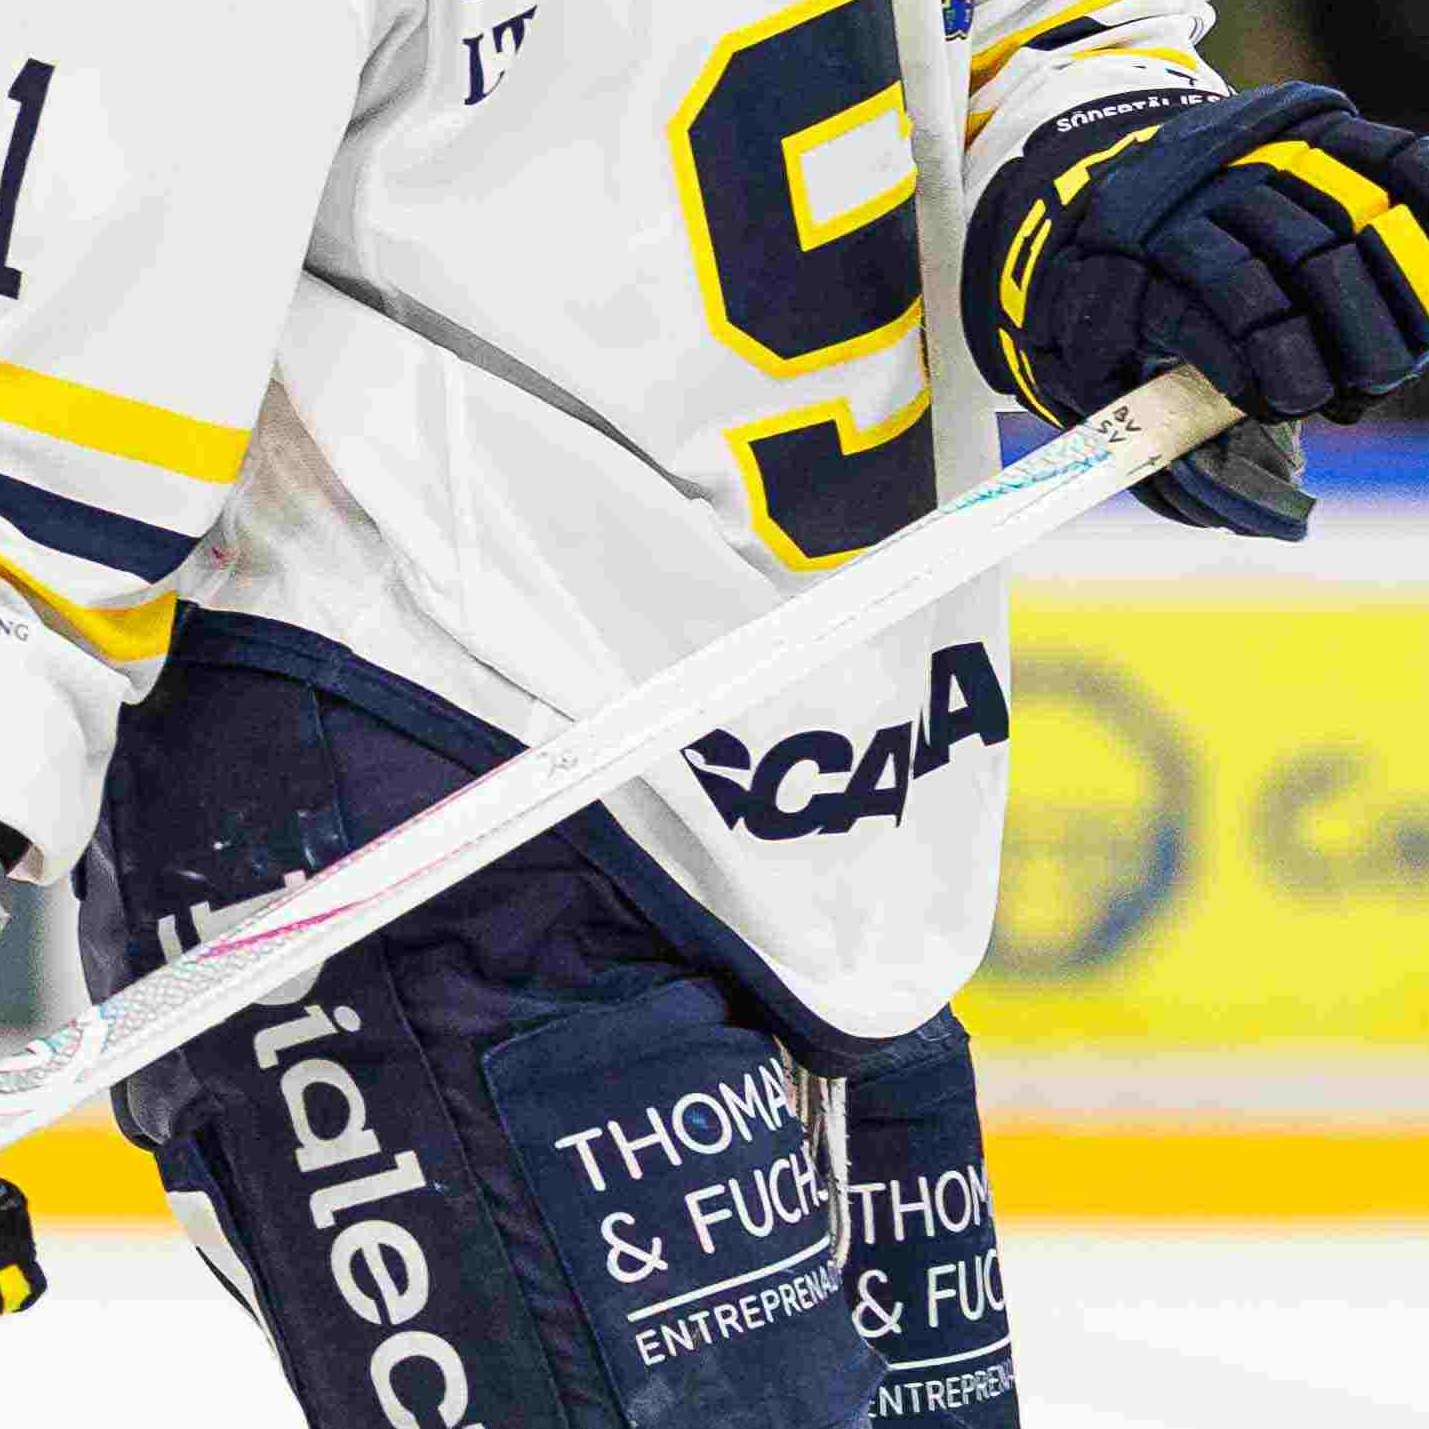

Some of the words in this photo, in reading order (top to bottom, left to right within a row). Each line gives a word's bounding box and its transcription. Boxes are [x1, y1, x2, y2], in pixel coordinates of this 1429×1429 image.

[680, 641, 1010, 841] SCAA
[158, 870, 487, 1429] ialec
[600, 1211, 669, 1284] &
[685, 1139, 830, 1255] FUCH
[851, 1269, 903, 1340] &
